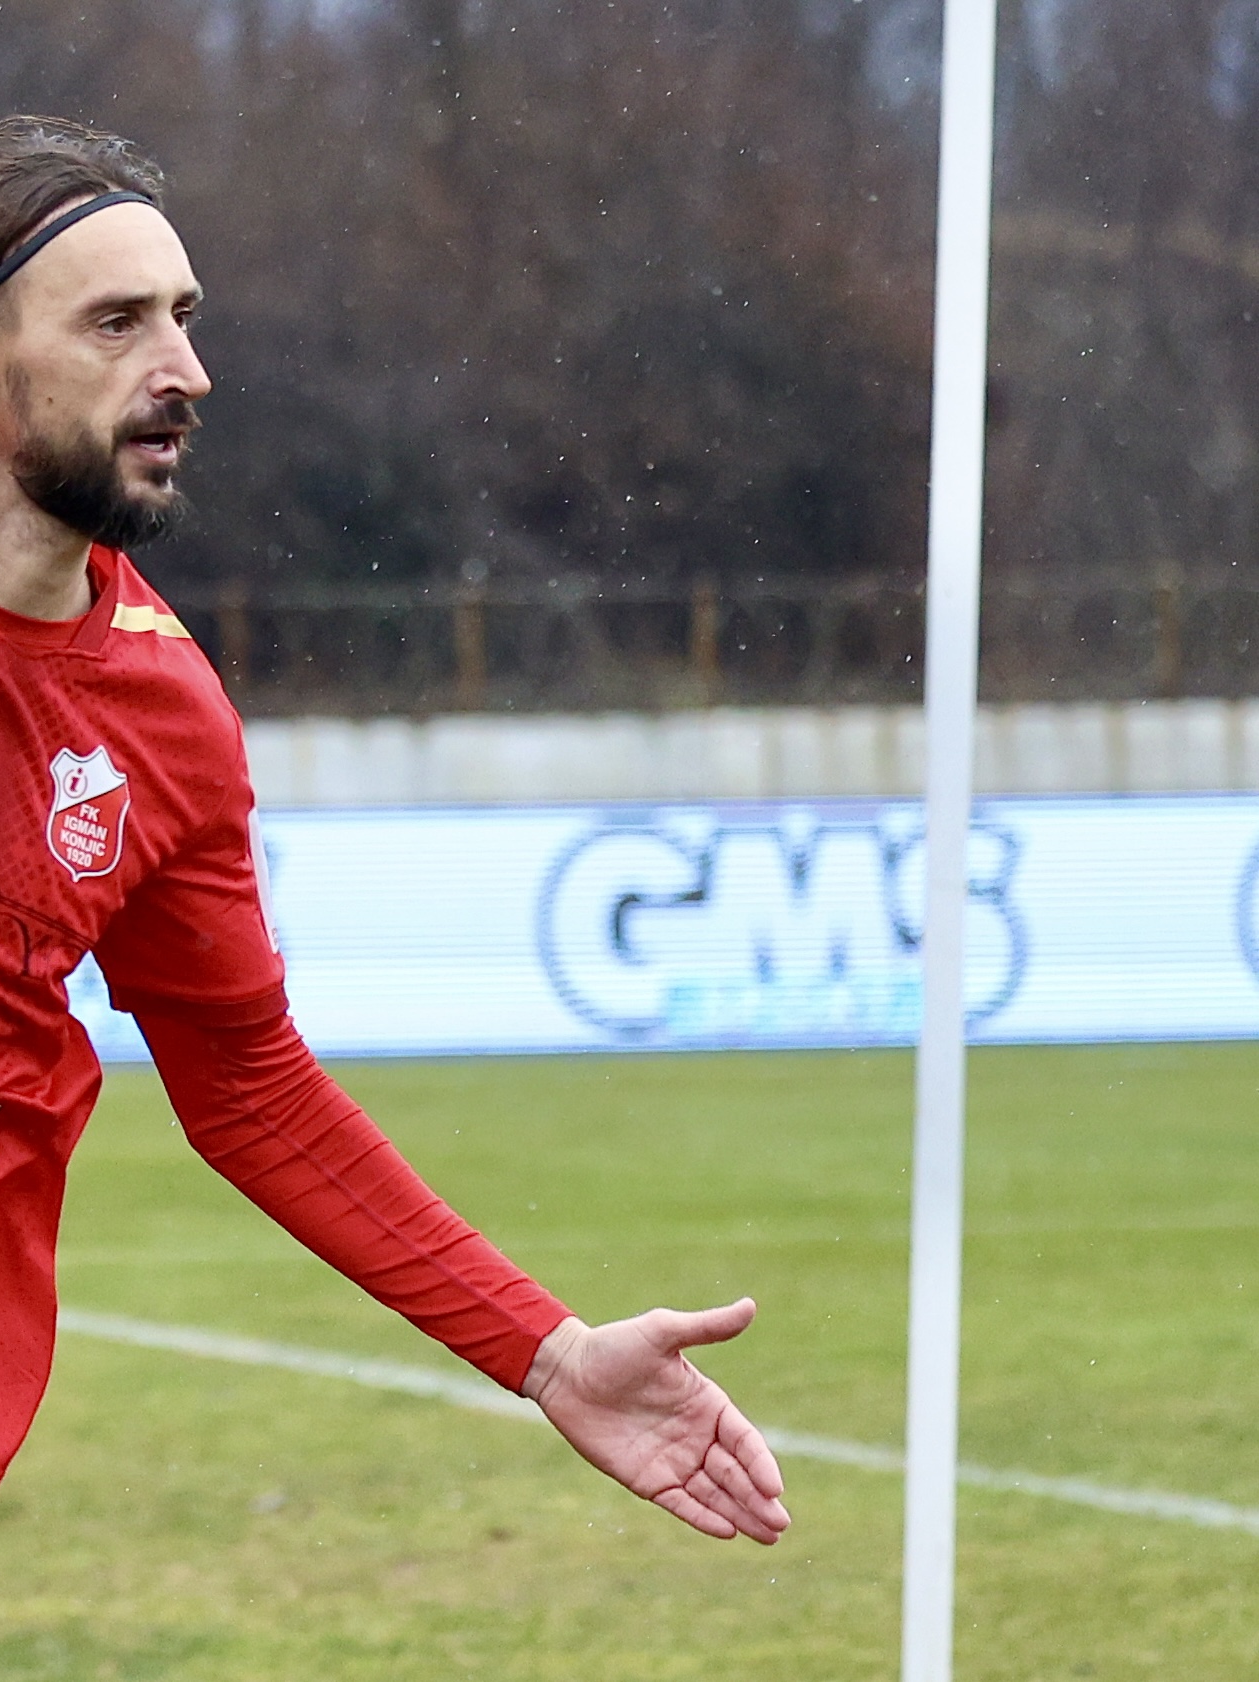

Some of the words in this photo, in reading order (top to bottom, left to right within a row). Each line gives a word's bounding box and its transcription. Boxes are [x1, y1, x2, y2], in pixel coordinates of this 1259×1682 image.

[79, 803, 100, 822] FK
[63, 814, 108, 841] IGMAN
[60, 829, 106, 857] KONJIC
[66, 846, 93, 868] 1920
[542, 820, 1027, 1029] GMS
